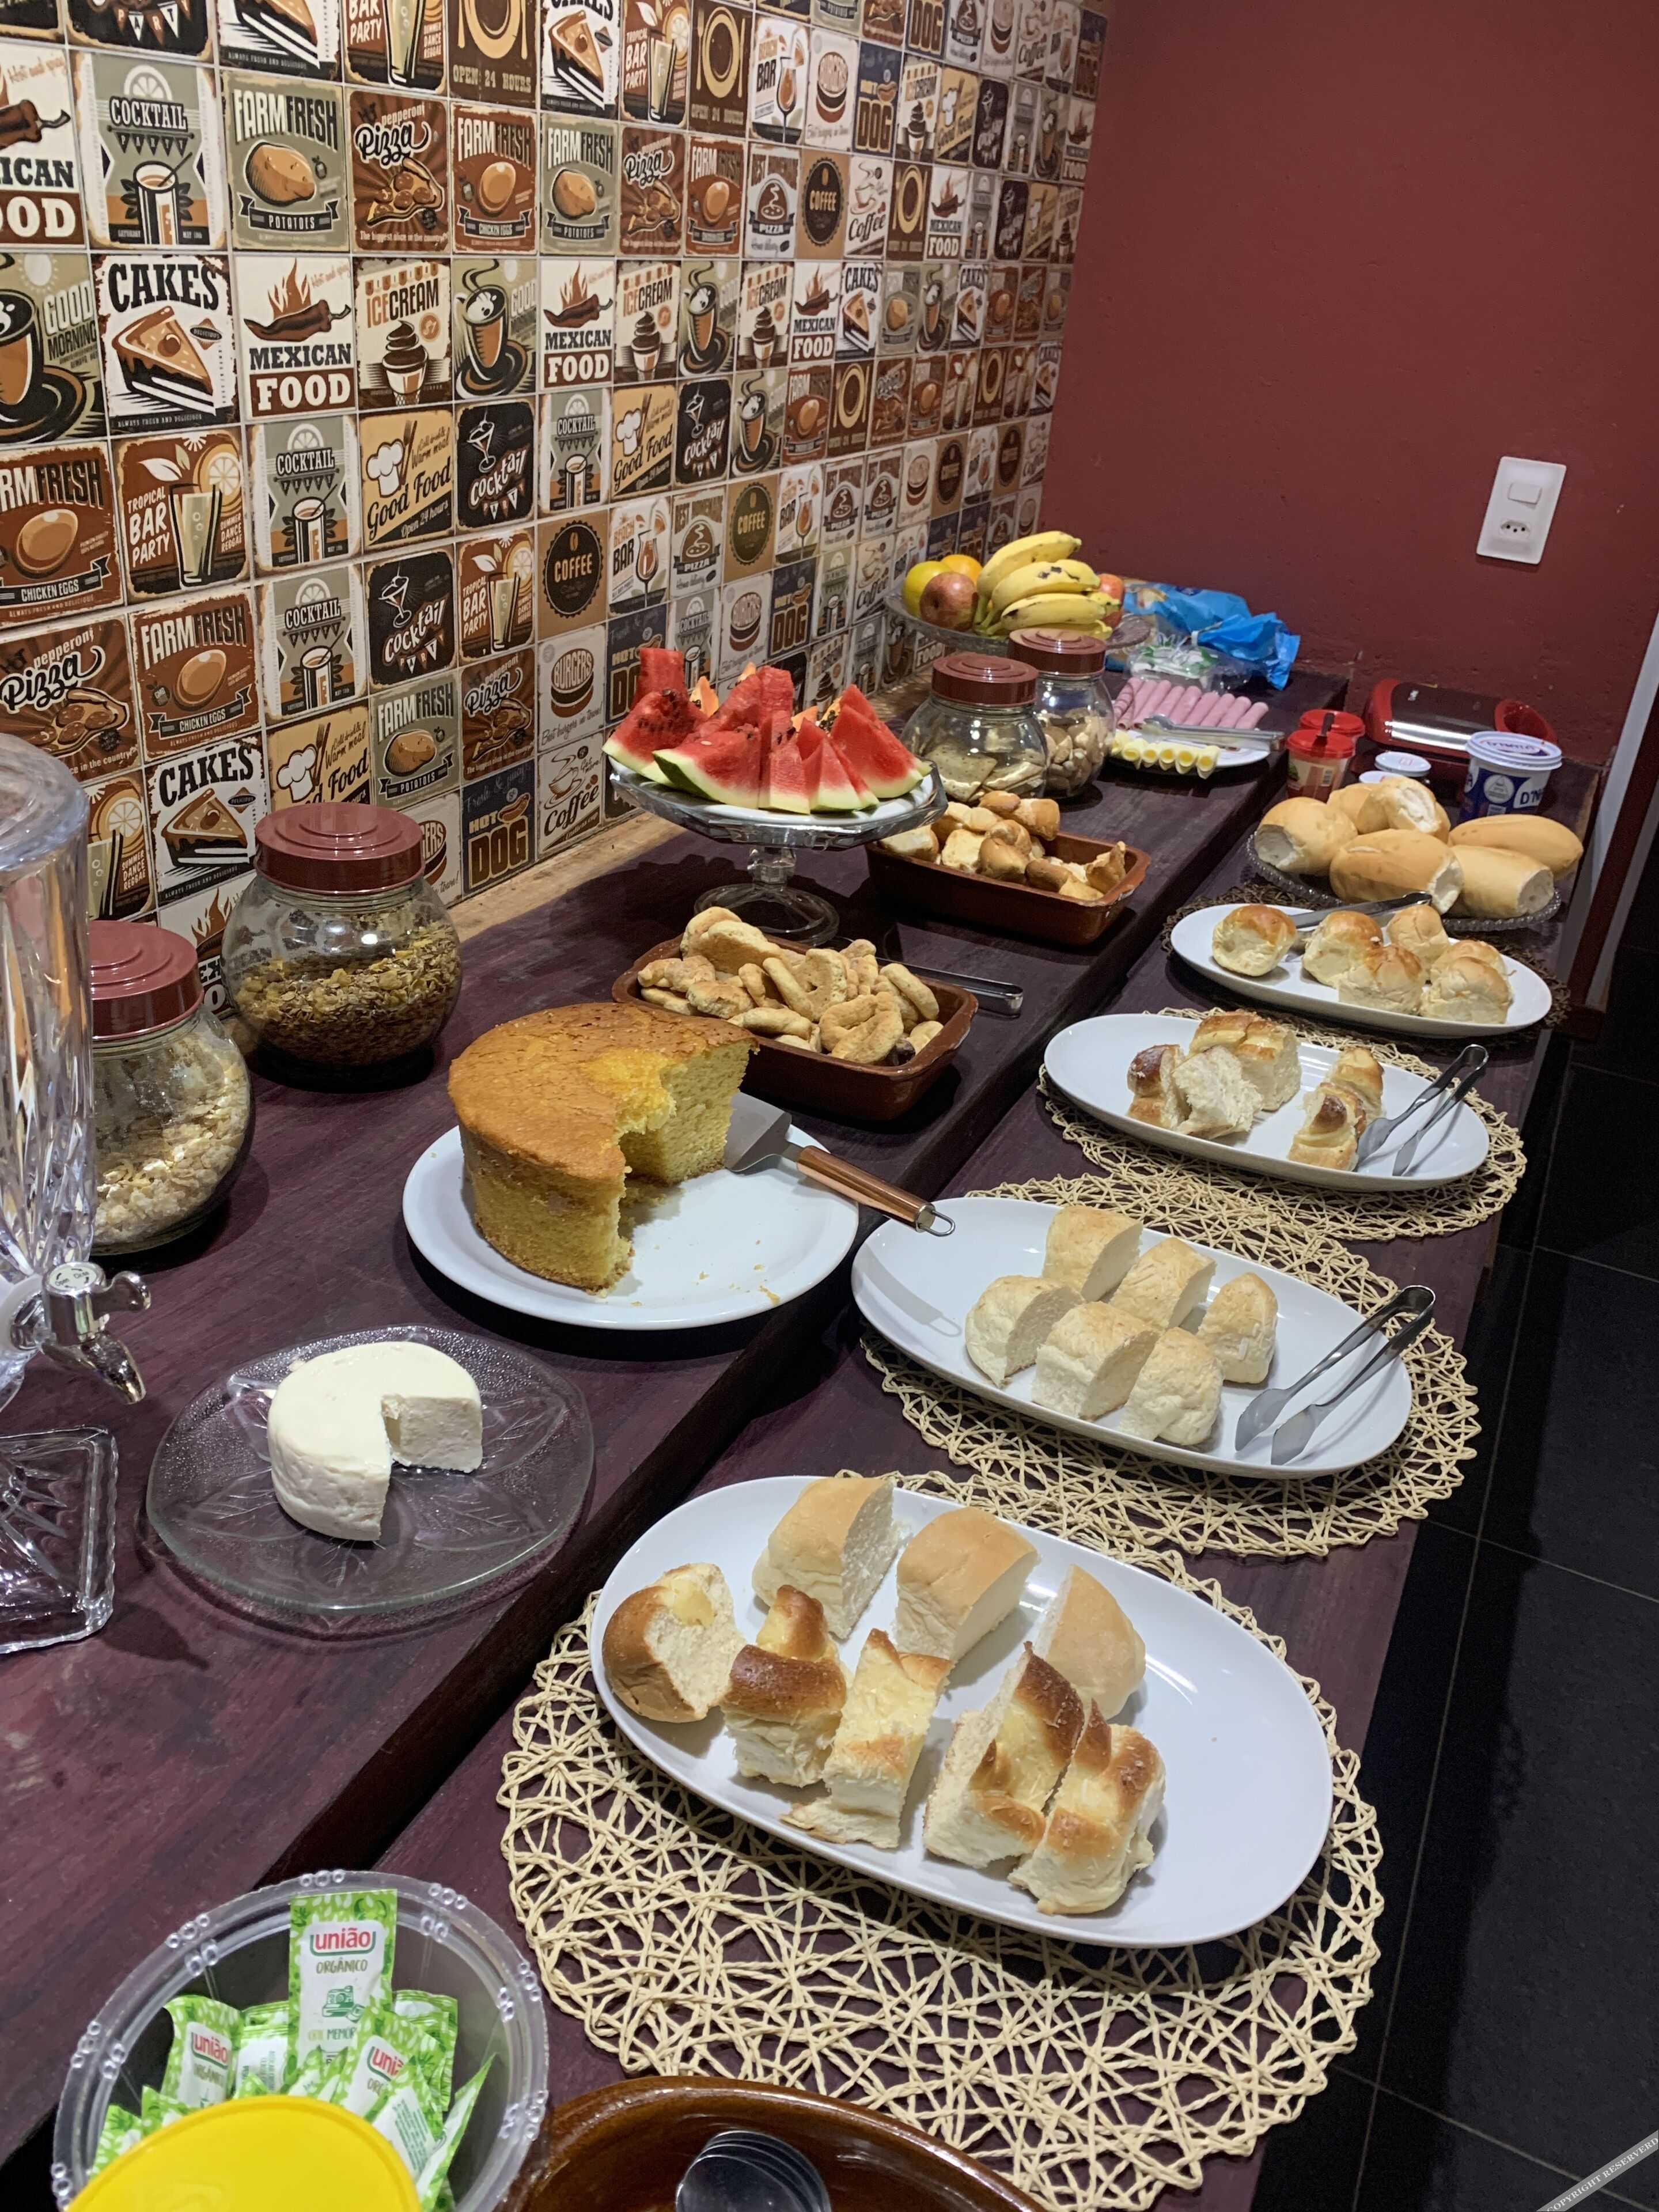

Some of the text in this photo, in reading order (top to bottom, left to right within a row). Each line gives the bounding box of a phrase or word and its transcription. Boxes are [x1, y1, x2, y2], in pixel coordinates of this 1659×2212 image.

[350, 17, 382, 45] PARTY
[626, 41, 647, 72] BAR
[452, 64, 479, 86] OPEN
[484, 69, 497, 88] 24
[624, 67, 648, 90] PARTY
[756, 59, 777, 93] BAR
[111, 99, 187, 130] COCKTAIL
[233, 89, 286, 144] FARM
[856, 97, 893, 151] DOG
[354, 120, 430, 167] Pizza
[0, 157, 74, 188] ICAN
[623, 150, 675, 187] Pizza
[0, 196, 76, 238] OD
[268, 214, 315, 230] POTATOES
[108, 263, 219, 313] CAKES
[366, 278, 440, 329] ICE CREAM
[43, 280, 94, 336] GOOD
[47, 320, 97, 361] MORNING
[545, 329, 612, 351] MEXICAN
[793, 336, 833, 360] FOOD
[249, 343, 352, 371] MEXICAN
[548, 353, 609, 384] FOOD
[256, 372, 351, 411] FOOD
[557, 414, 596, 436] COCKTAIL
[276, 449, 335, 475] COCKTAIL
[127, 486, 166, 514] TROPICAL
[367, 455, 451, 541] Good Food
[129, 502, 167, 546] BAR
[221, 522, 242, 543] DANCE
[737, 510, 766, 535] COFFEE
[132, 532, 171, 568] PARTY
[221, 534, 243, 553] REGGAE
[612, 538, 634, 576] BAR
[554, 552, 593, 583] COFFEE
[684, 558, 710, 572] PIZZA
[21, 578, 79, 603] CHICKEN EGGS
[285, 601, 341, 628] COCKTAIL
[463, 591, 487, 622] BAR
[463, 611, 488, 639] PARTY
[772, 604, 809, 655] DOG
[33, 628, 95, 669] pepperoni
[141, 615, 195, 671] FARM
[1, 645, 106, 712] Pizza
[553, 649, 593, 690] BURGERS
[465, 667, 522, 716] Pizza
[179, 708, 226, 733] CHICKEN EGGS
[377, 682, 454, 744] FARM FRESH
[159, 745, 253, 807] CAKES
[328, 747, 369, 801] Food
[400, 772, 436, 793] POTATOES
[468, 810, 498, 834] HOT
[544, 785, 600, 837] Coffee
[121, 850, 144, 871] SUMMER
[468, 815, 529, 890] DOG
[122, 861, 145, 881] DANCE
[123, 870, 147, 890] REGGAE
[315, 1927, 371, 1950] união
[316, 1956, 368, 1975] ORGÂNICO
[194, 2033, 228, 2064] união
[372, 2047, 404, 2077] uni
